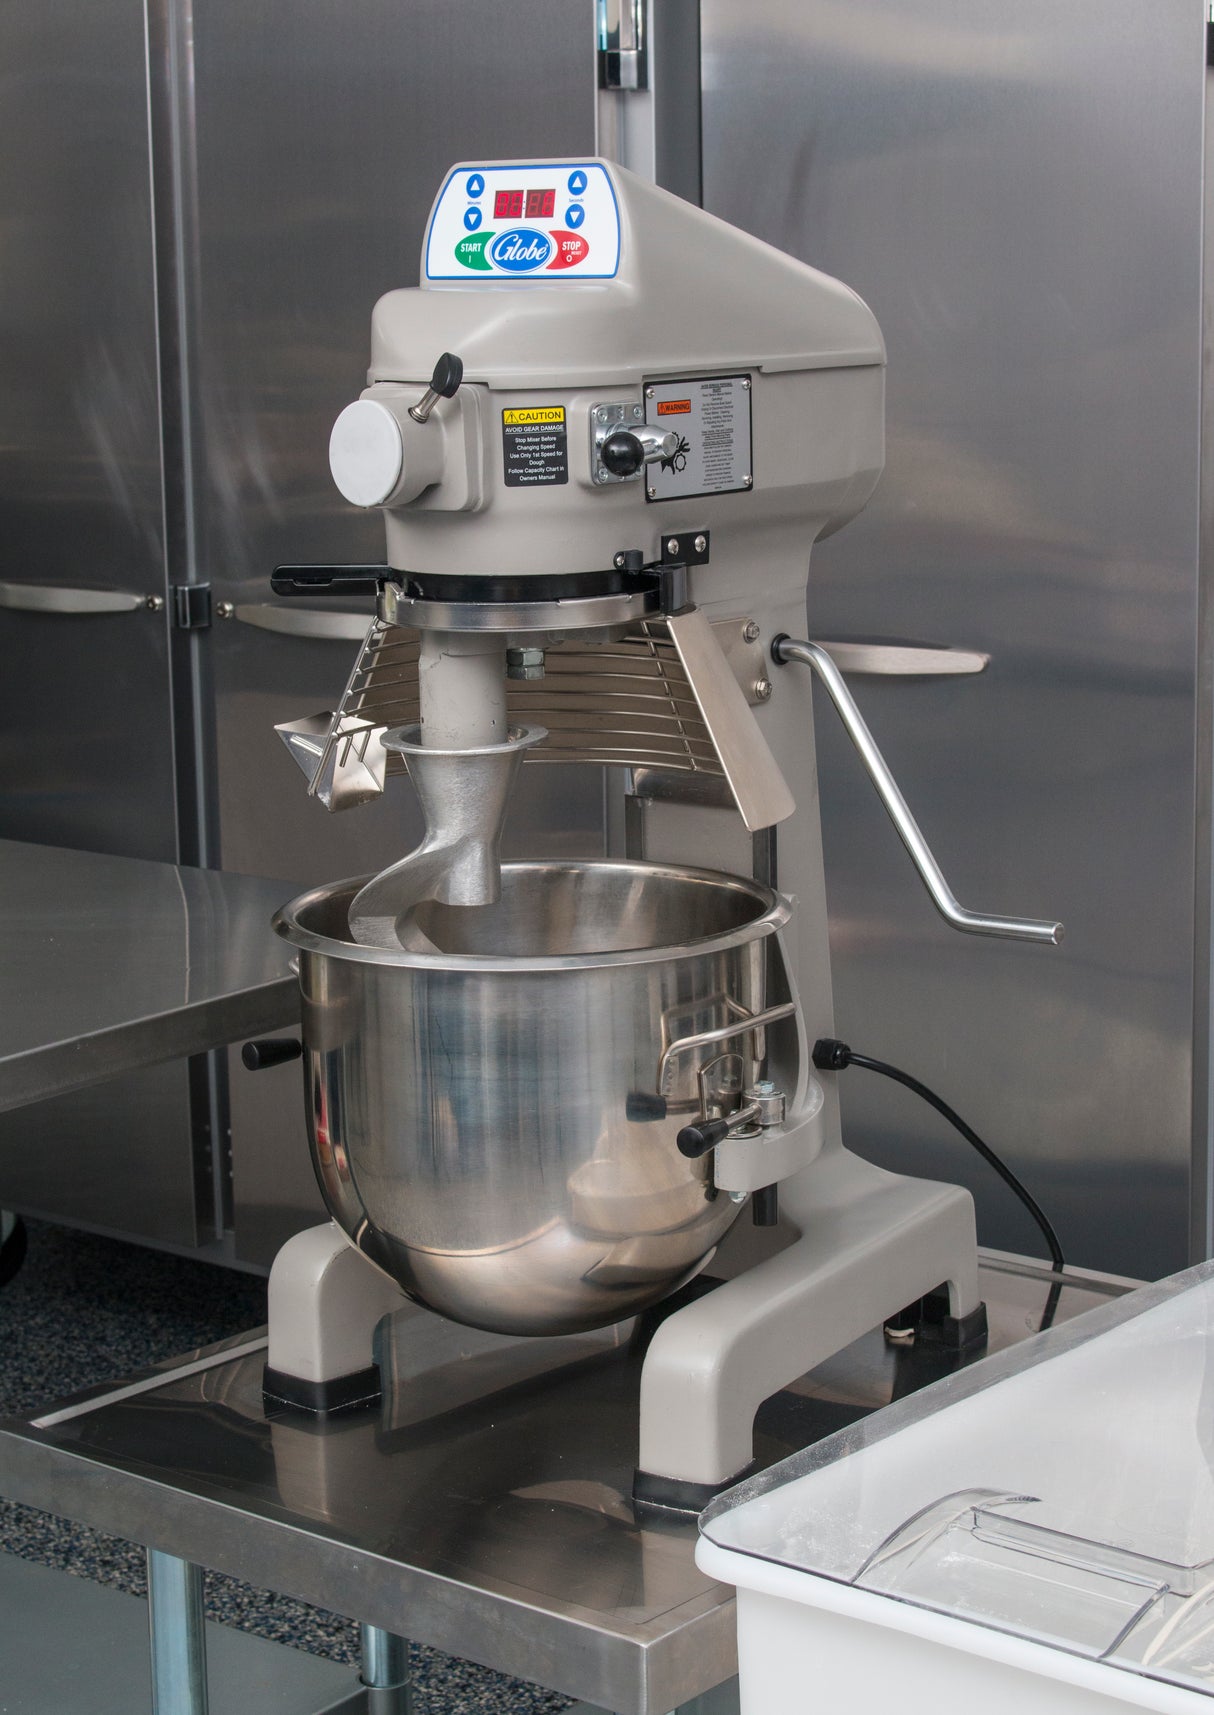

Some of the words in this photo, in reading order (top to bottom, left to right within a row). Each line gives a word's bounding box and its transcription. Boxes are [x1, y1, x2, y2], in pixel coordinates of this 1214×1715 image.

[460, 242, 482, 252] START
[494, 233, 549, 261] Globe
[561, 241, 581, 251] STOP
[665, 402, 690, 411] WARNING
[518, 411, 562, 421] CAUTION
[524, 466, 545, 474] Capacity
